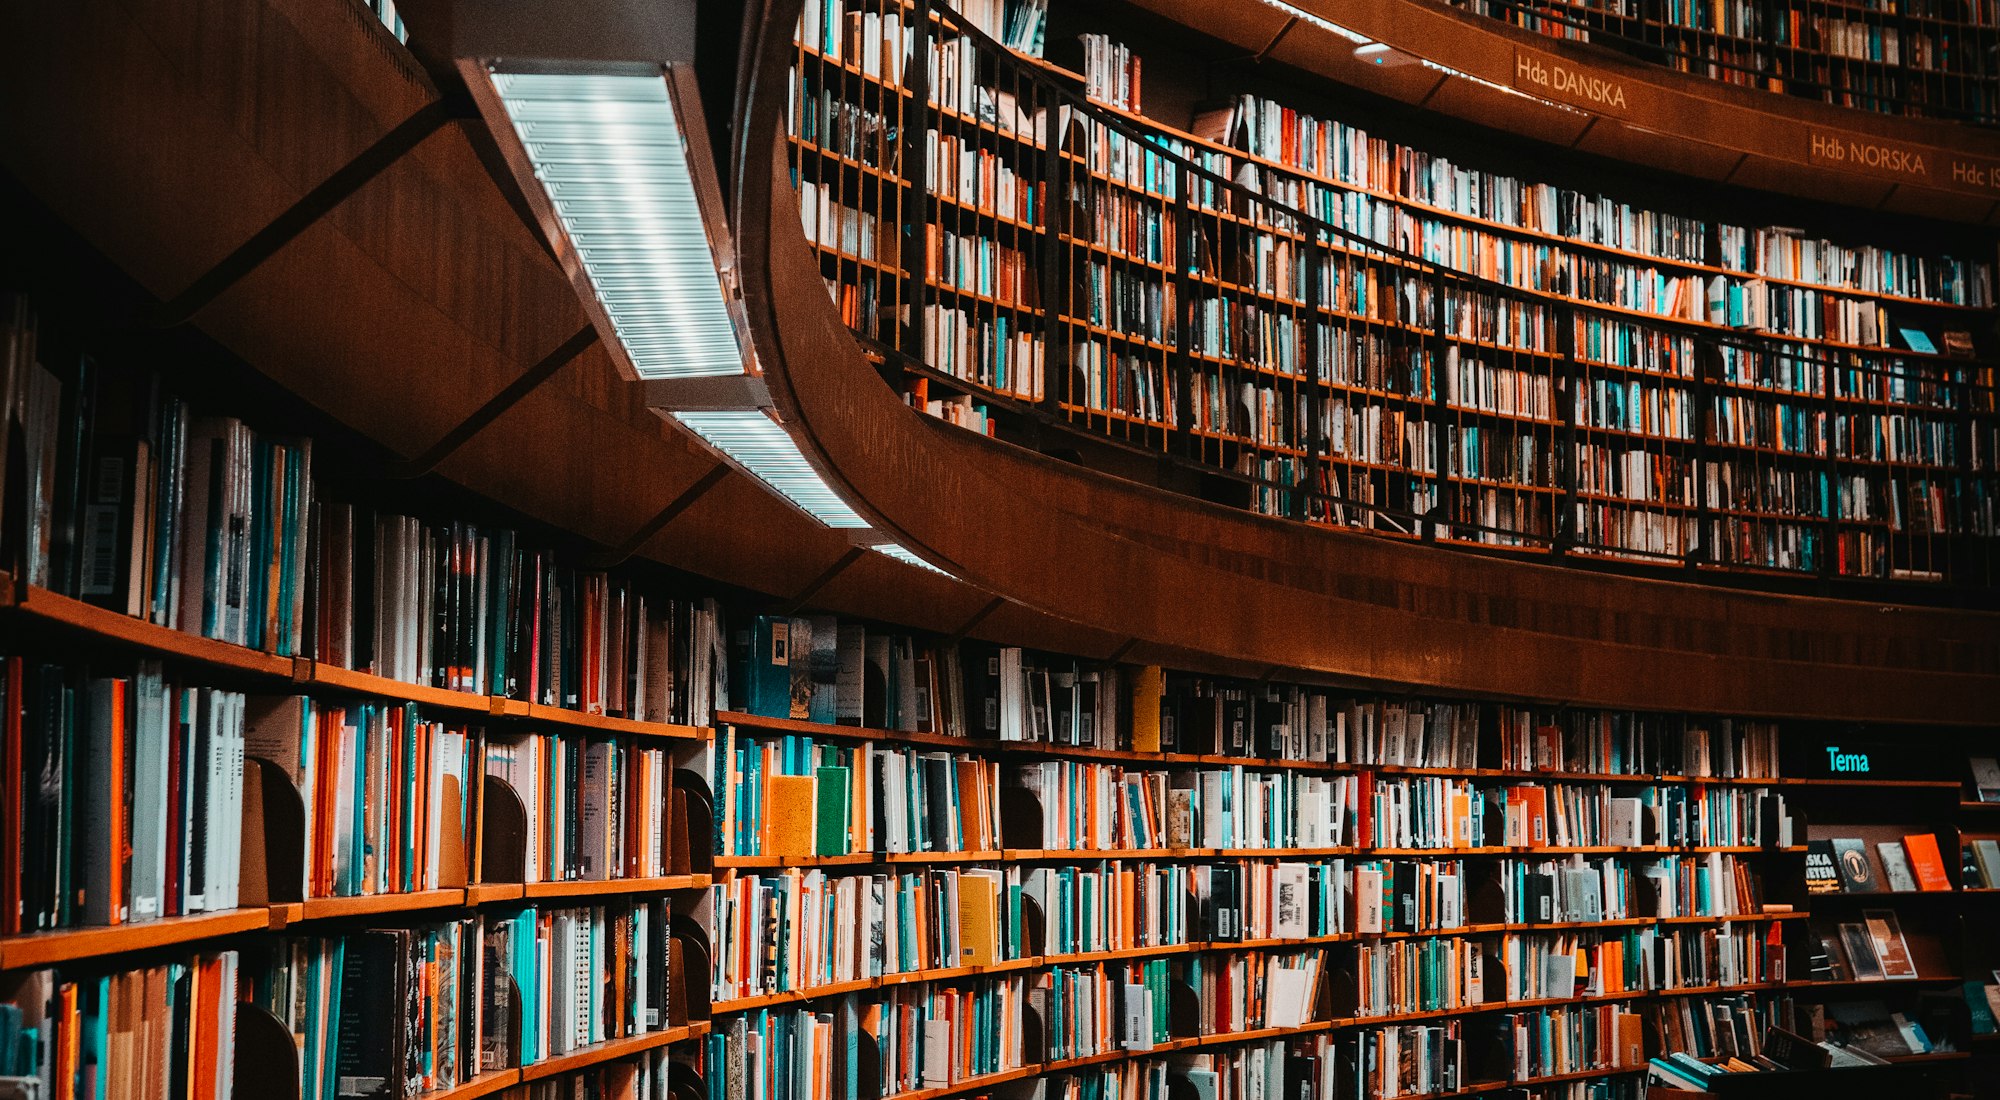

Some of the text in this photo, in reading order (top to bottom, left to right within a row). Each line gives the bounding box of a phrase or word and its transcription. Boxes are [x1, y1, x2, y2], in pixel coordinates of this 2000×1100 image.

[1518, 55, 1626, 109] Hda DANSKA
[1812, 134, 1926, 175] Hdb NORSKA
[1952, 161, 1985, 186] Hdc
[1826, 746, 1870, 772] Tema
